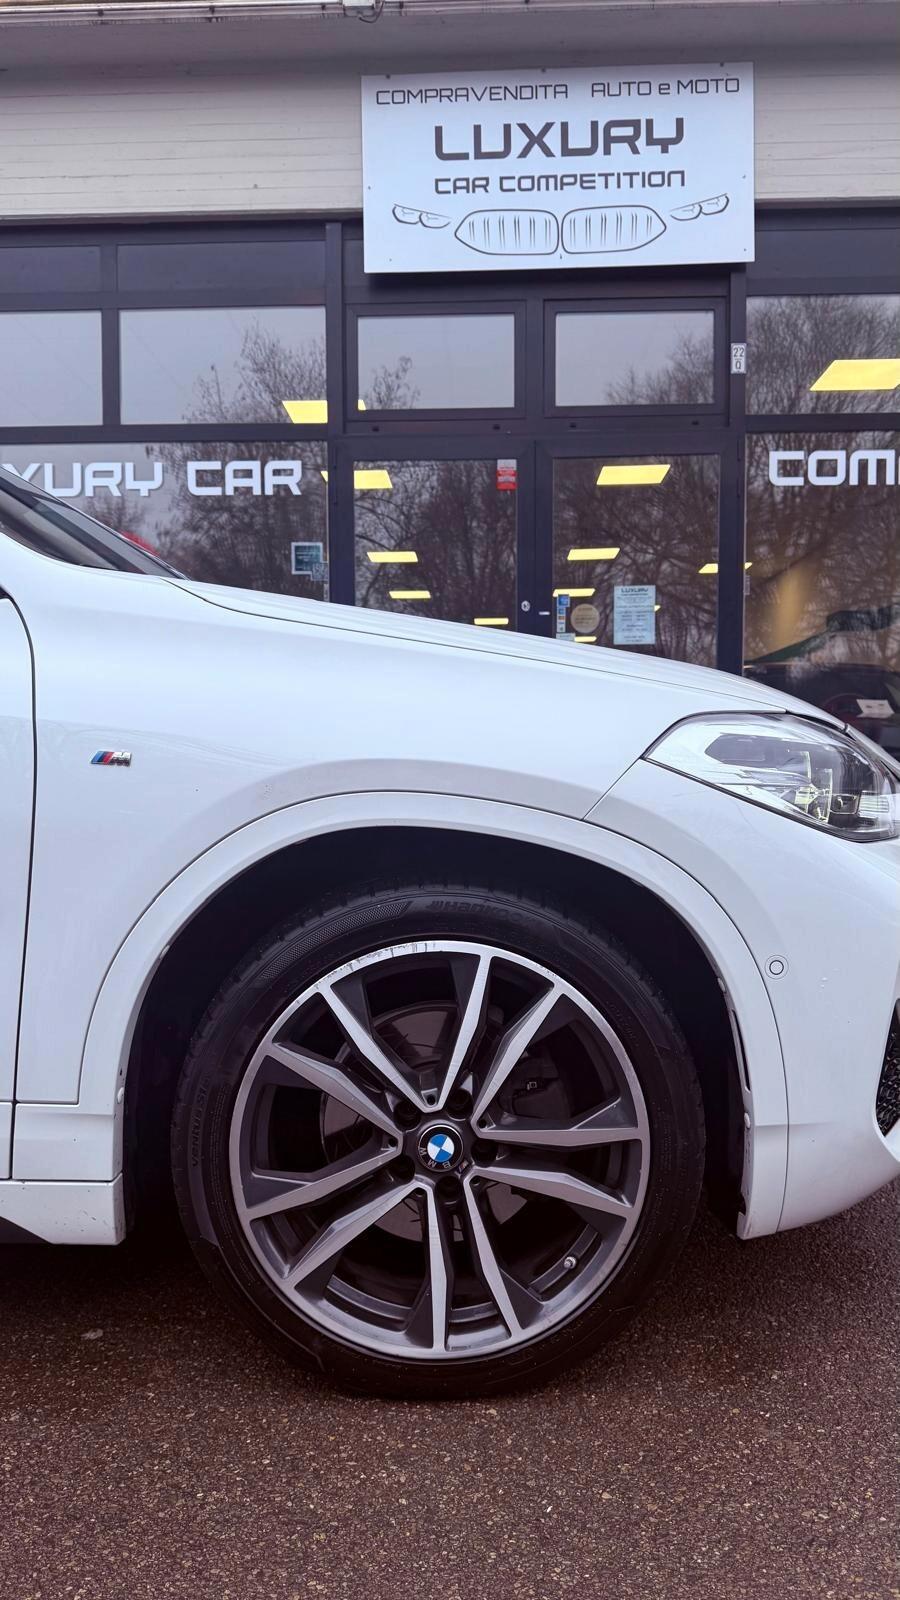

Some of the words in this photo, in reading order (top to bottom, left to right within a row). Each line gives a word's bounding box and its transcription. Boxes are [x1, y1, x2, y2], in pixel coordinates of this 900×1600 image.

[376, 84, 568, 105] COMPRAVENDITA
[591, 81, 652, 98] AUTO
[658, 82, 671, 95] e
[677, 78, 740, 95] MOTO
[434, 117, 684, 161] LUXURY
[434, 175, 490, 195] CAR
[499, 170, 685, 193] COMPETITION
[733, 347, 745, 358] 22
[187, 460, 302, 496] CAR
[768, 449, 900, 486] COM
